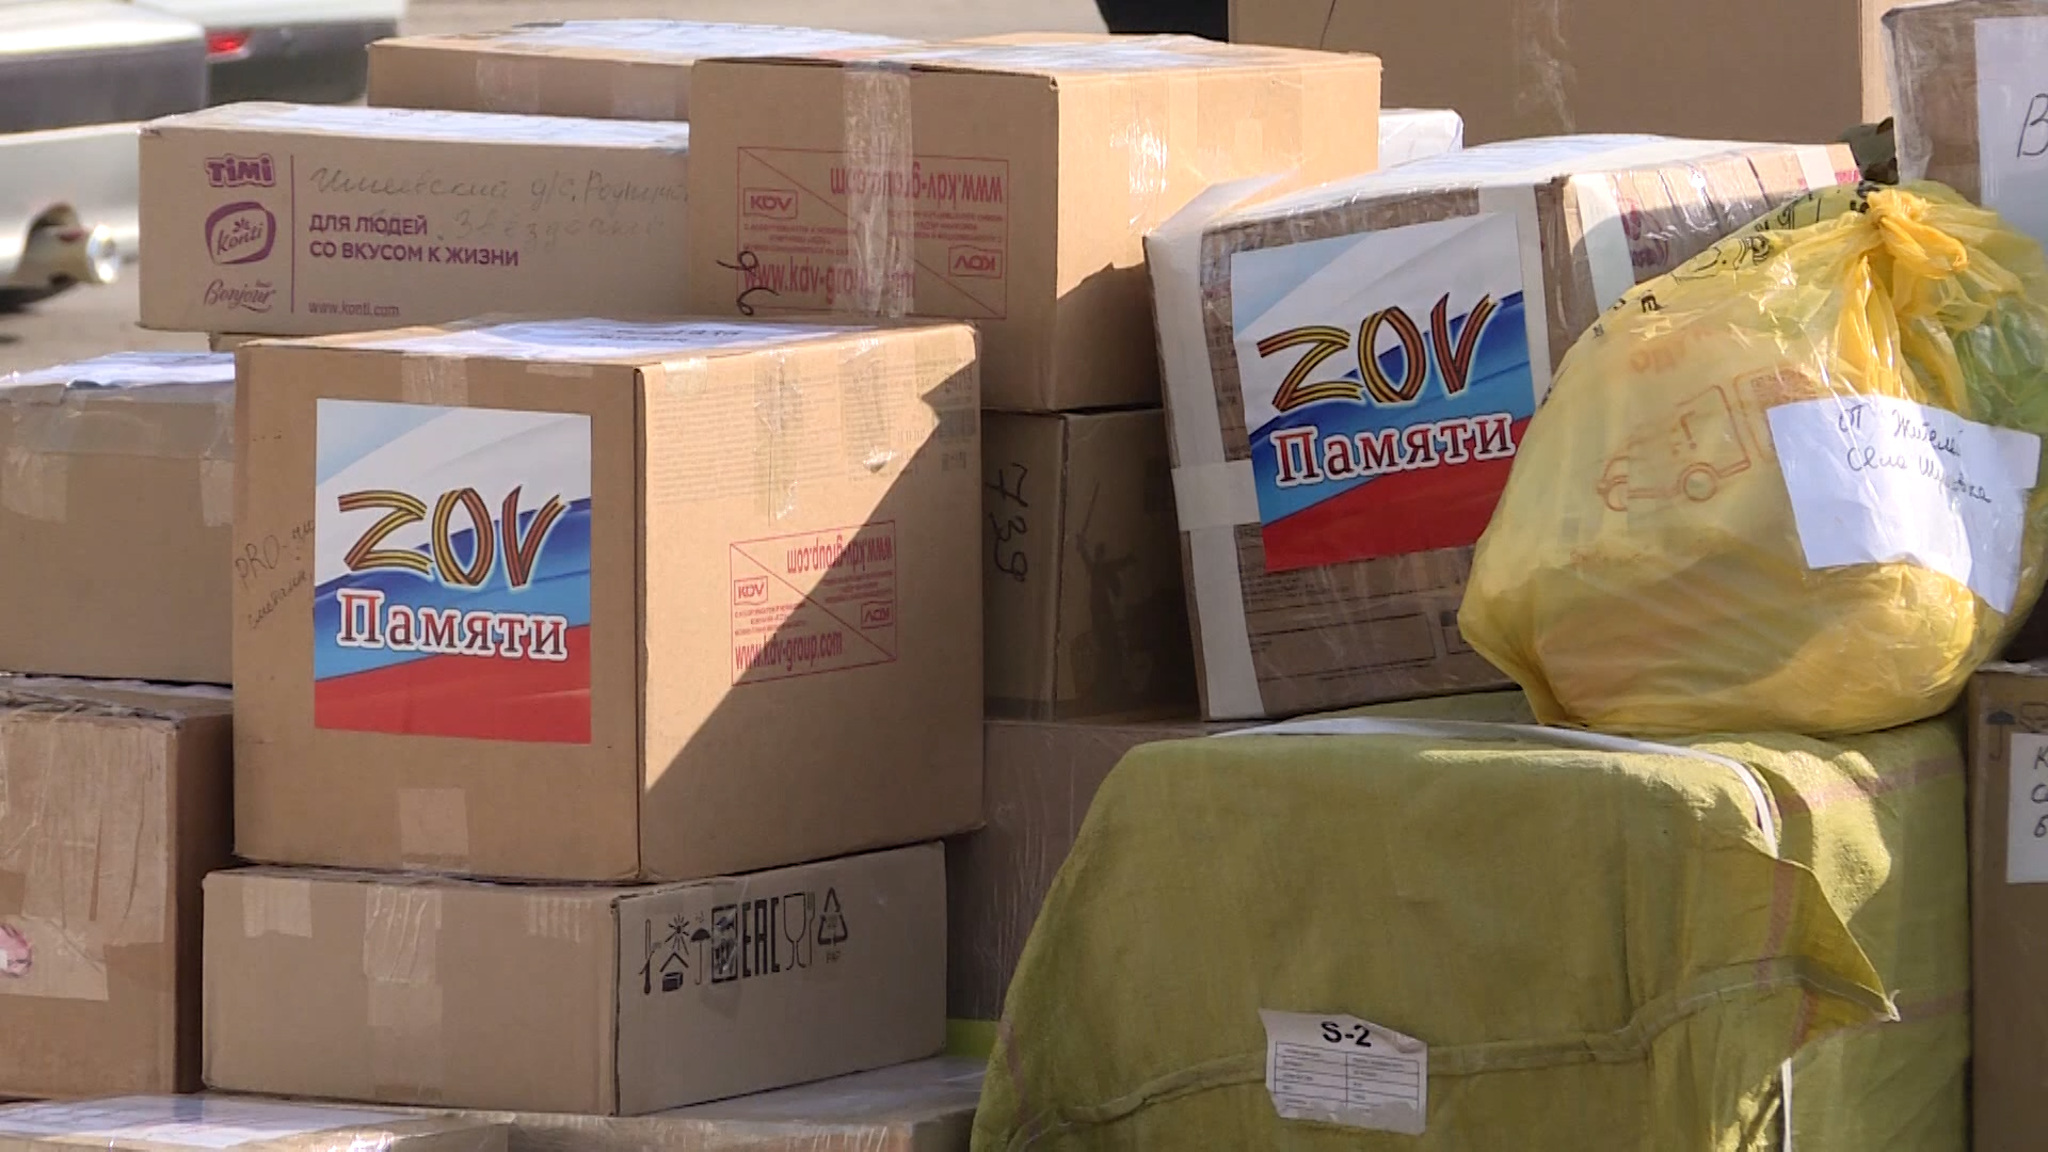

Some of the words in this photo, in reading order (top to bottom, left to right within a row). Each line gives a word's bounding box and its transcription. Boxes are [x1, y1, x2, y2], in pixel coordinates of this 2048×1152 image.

[584, 169, 688, 211] Родничо
[749, 195, 793, 212] KDV
[309, 214, 351, 233] ДЛЯ
[355, 213, 428, 237] ЛЮДЕЙ
[309, 241, 338, 259] СО
[341, 243, 424, 263] ВКУСОМ
[428, 246, 441, 264] К
[446, 248, 519, 268] ЖИЗНИ
[954, 253, 996, 271] KDV
[203, 278, 277, 313] Bonjour
[308, 301, 401, 318] www.konti.com
[1257, 291, 1500, 413] ZOV
[1271, 413, 1515, 487] Памяти
[338, 485, 567, 588] ZOV
[984, 462, 1029, 582] 739
[786, 534, 893, 574] www.kdv-group.com
[737, 582, 765, 600] KDV
[337, 589, 568, 660] Памяти
[735, 630, 843, 672] www.kdv-group.com
[742, 897, 781, 978] EAC
[1321, 1020, 1372, 1048] S-2
